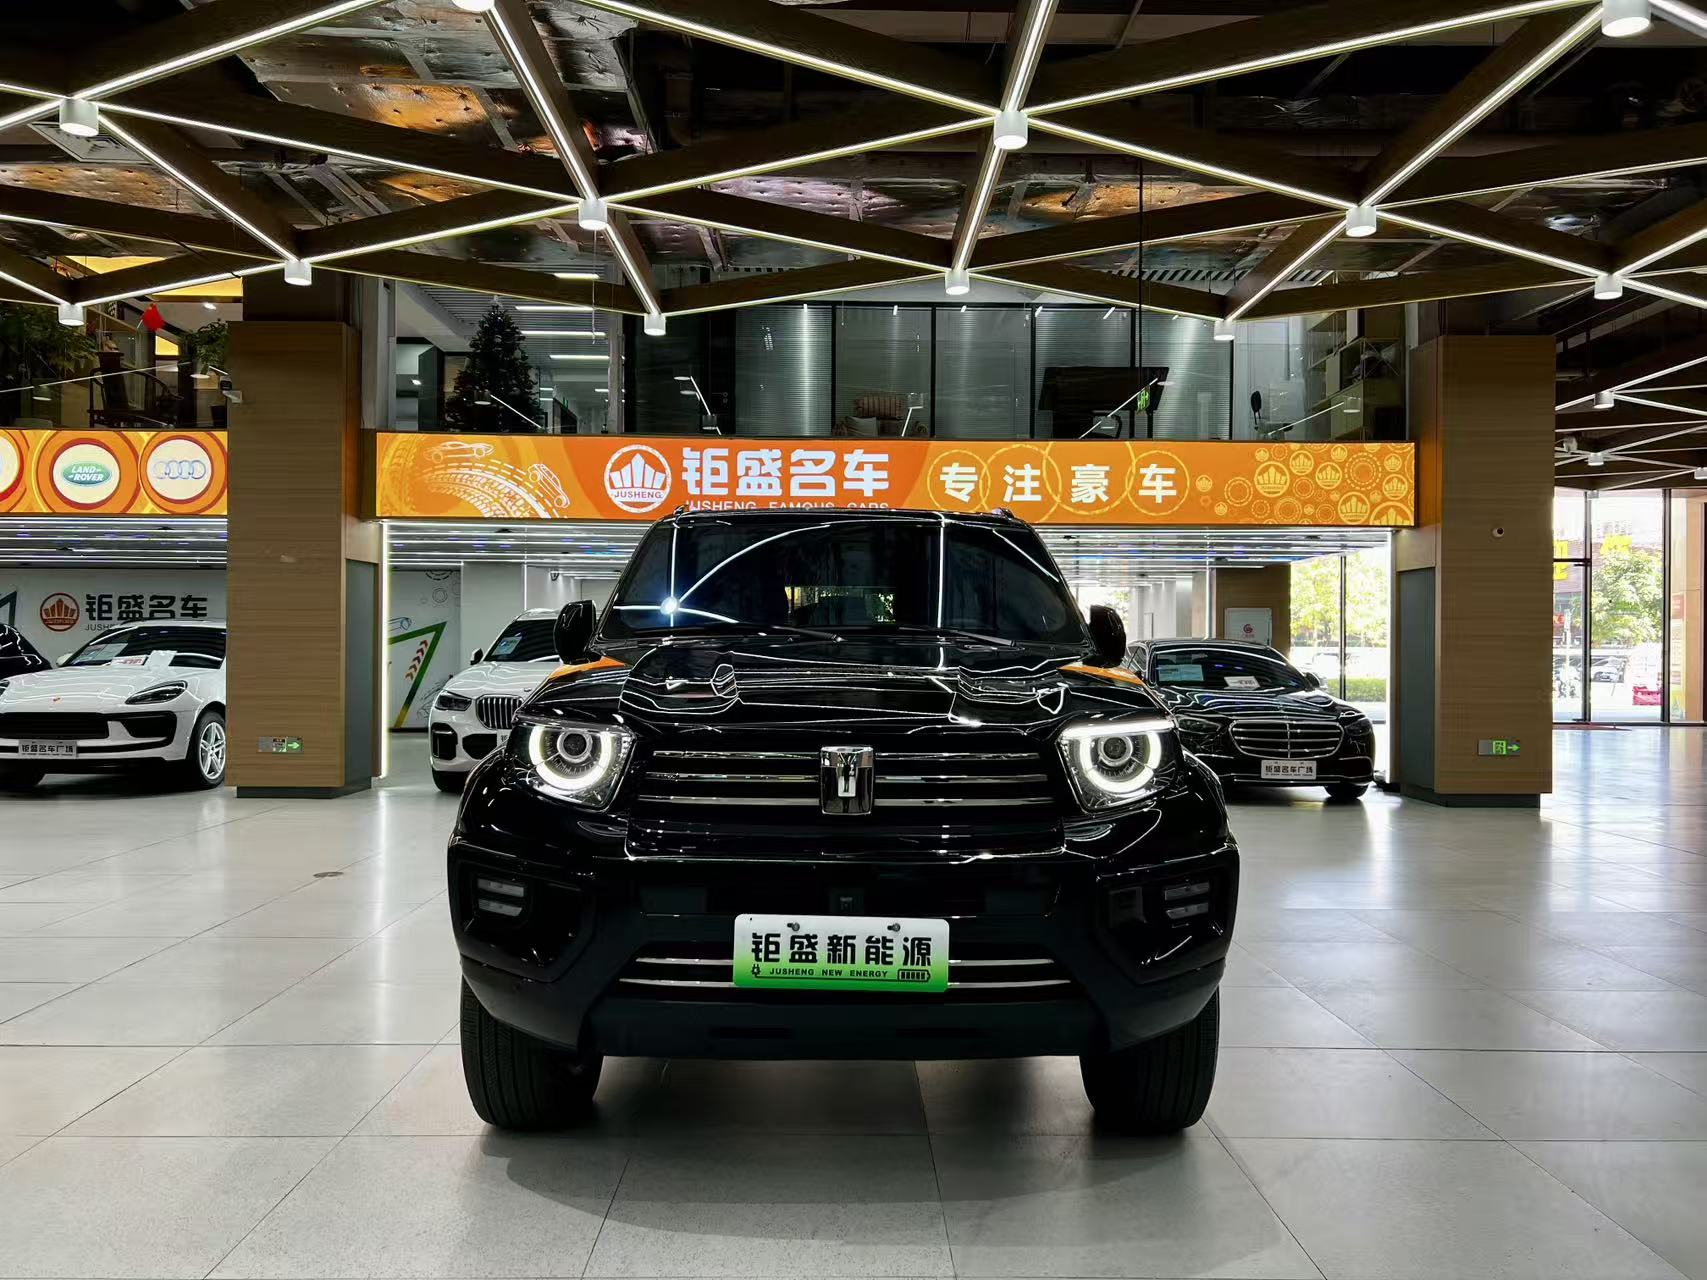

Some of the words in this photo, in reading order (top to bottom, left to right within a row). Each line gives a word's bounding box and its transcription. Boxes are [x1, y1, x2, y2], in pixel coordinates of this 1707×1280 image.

[681, 447, 890, 497] 钜盛名车
[939, 462, 1177, 504] 专注豪车
[614, 490, 663, 499] JUSHENG
[85, 593, 208, 621] 钜盛名车
[751, 932, 932, 967] 钜盛新能源
[769, 967, 815, 976] JUSHENG
[821, 969, 843, 977] NEW
[849, 970, 888, 979] ENERGY
